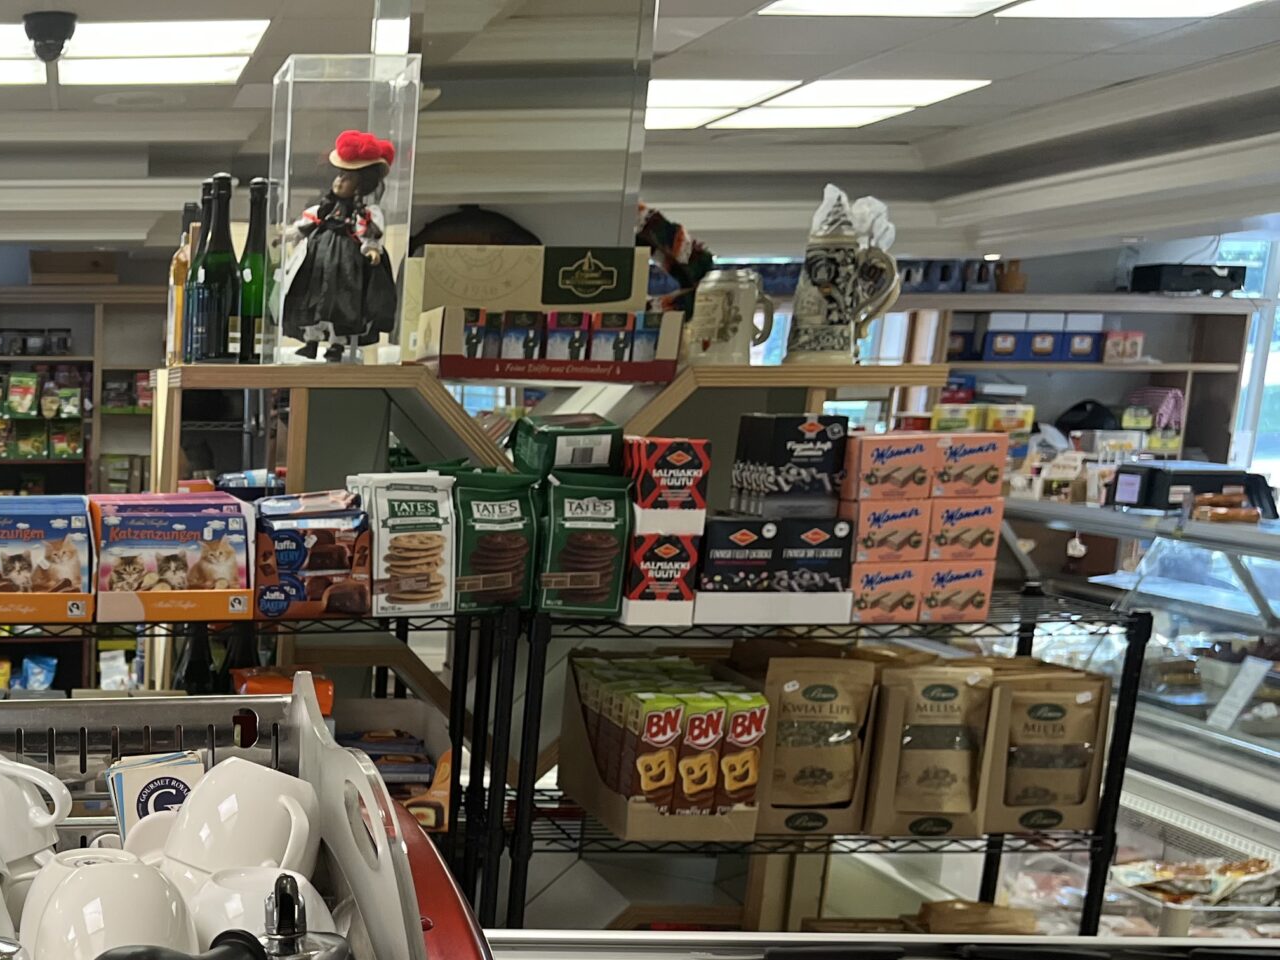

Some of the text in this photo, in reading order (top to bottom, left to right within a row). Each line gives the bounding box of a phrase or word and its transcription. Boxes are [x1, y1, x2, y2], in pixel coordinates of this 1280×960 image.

[871, 443, 925, 464] Manner
[944, 442, 997, 462] Manner
[392, 501, 435, 513] TATE'S
[473, 502, 518, 515] TATE'S
[941, 506, 994, 526] Manner
[868, 507, 921, 528] Manner
[110, 527, 201, 543] Katzenzungen
[861, 570, 913, 590] Manner
[932, 569, 985, 588] Manner
[263, 591, 285, 600] Jaffa
[646, 706, 683, 739] BN
[689, 709, 724, 741] BN
[732, 706, 767, 739] BN
[140, 779, 169, 802] GOURMET
